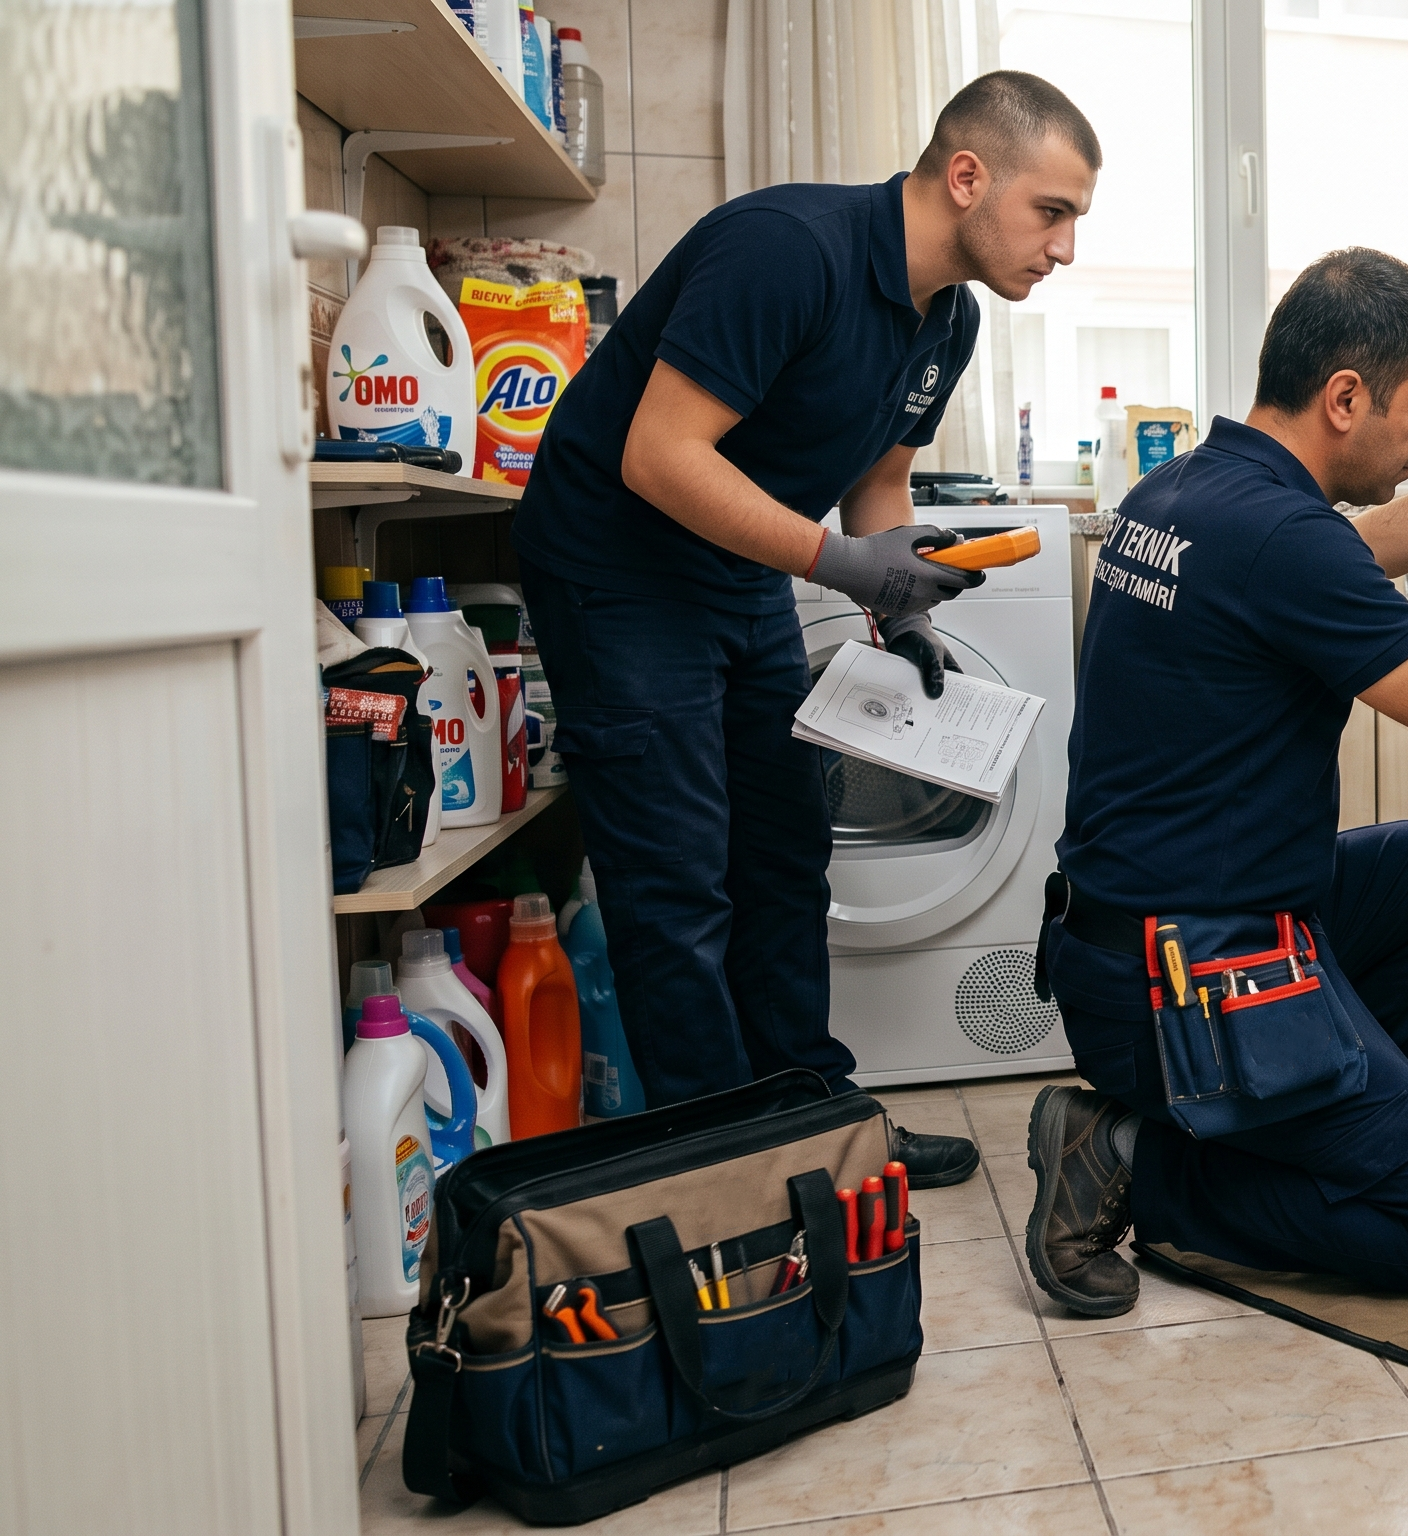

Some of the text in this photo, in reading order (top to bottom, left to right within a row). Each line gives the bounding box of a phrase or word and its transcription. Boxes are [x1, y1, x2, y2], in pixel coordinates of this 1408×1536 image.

[355, 375, 418, 406] OMO
[478, 367, 557, 414] ALO
[1117, 519, 1193, 577] TEKNİK
[1127, 574, 1178, 611] TAMİRİ
[432, 718, 465, 745] MO
